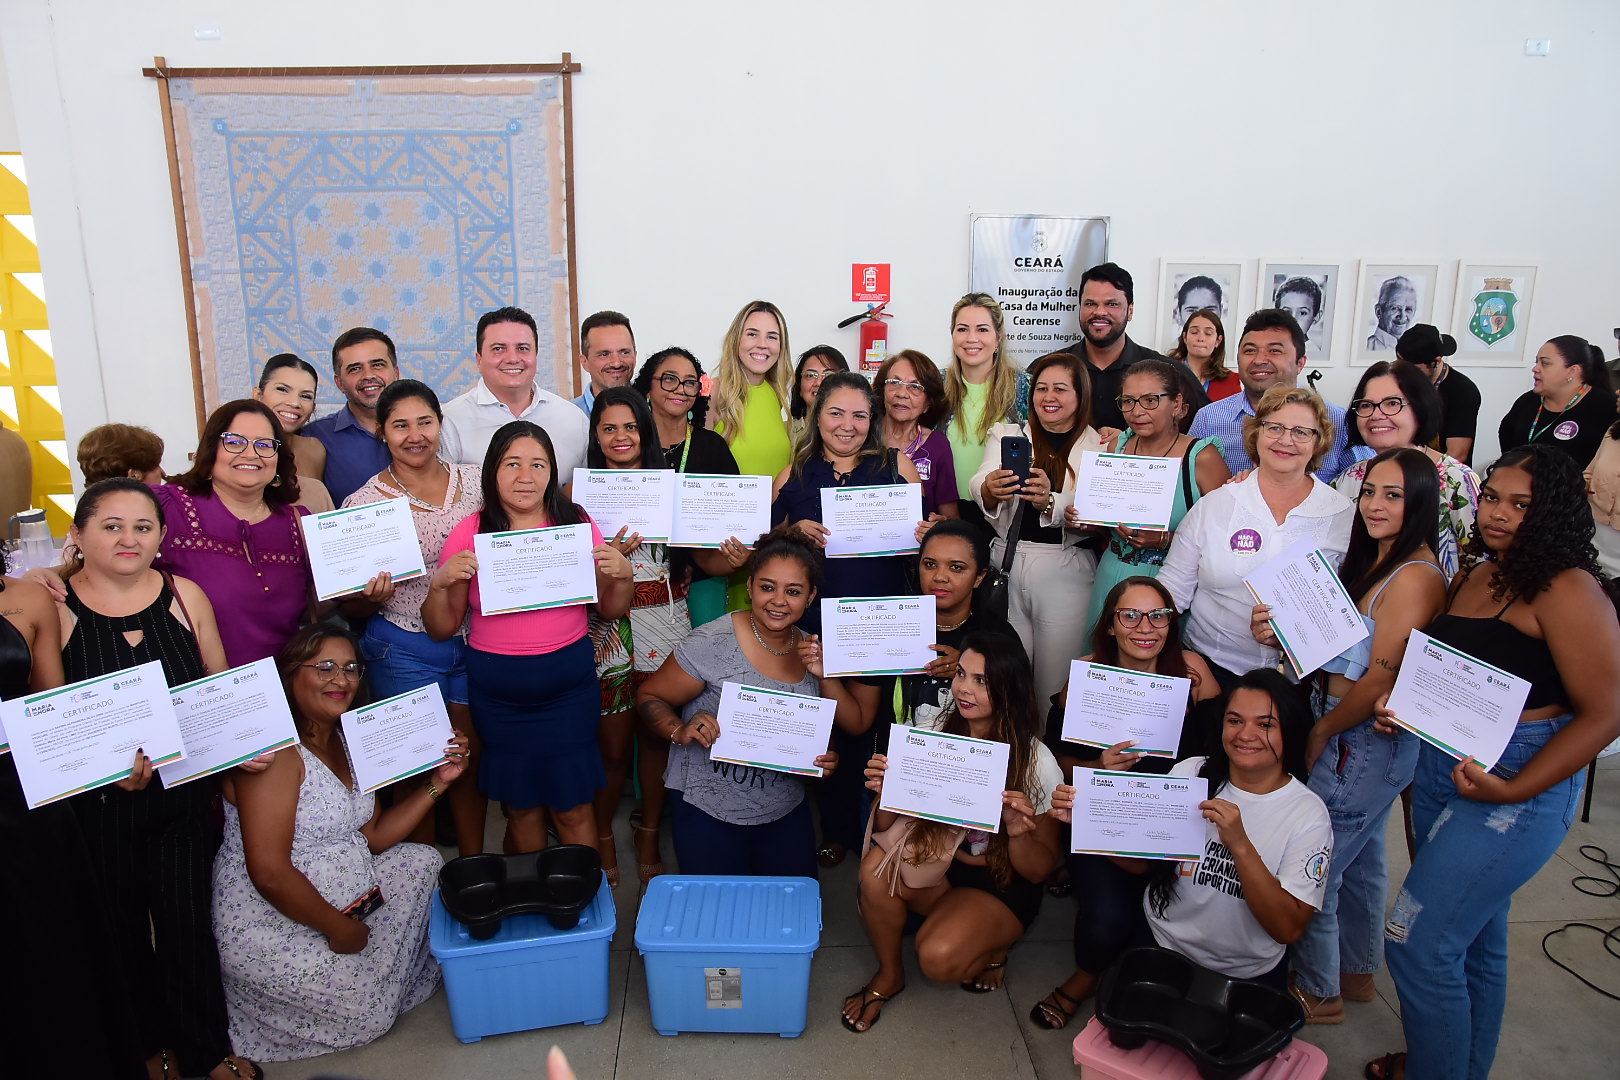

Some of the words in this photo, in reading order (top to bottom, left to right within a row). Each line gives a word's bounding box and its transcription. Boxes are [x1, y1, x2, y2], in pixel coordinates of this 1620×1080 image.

[1014, 254, 1063, 268] CEARÁ
[998, 286, 1062, 299] Inauguração
[1066, 287, 1078, 296] da
[999, 301, 1022, 310] Casa
[1026, 301, 1038, 311] da
[1041, 302, 1077, 312] Mulher
[1013, 316, 1060, 325] Cearense
[1054, 333, 1082, 342] Negrão
[342, 523, 376, 534] CERTIFICADO
[1312, 579, 1333, 612] CERTIFICADO
[1443, 668, 1480, 690] CERTIFICADO
[1109, 686, 1145, 697] CERTIFICADO
[191, 692, 234, 710] CERTIFICADO
[62, 699, 114, 718] CERTIFICADO
[759, 707, 794, 716] CERTIFICADO
[380, 711, 412, 725] CERTIFICADO
[928, 751, 966, 762] CERTIFICADO
